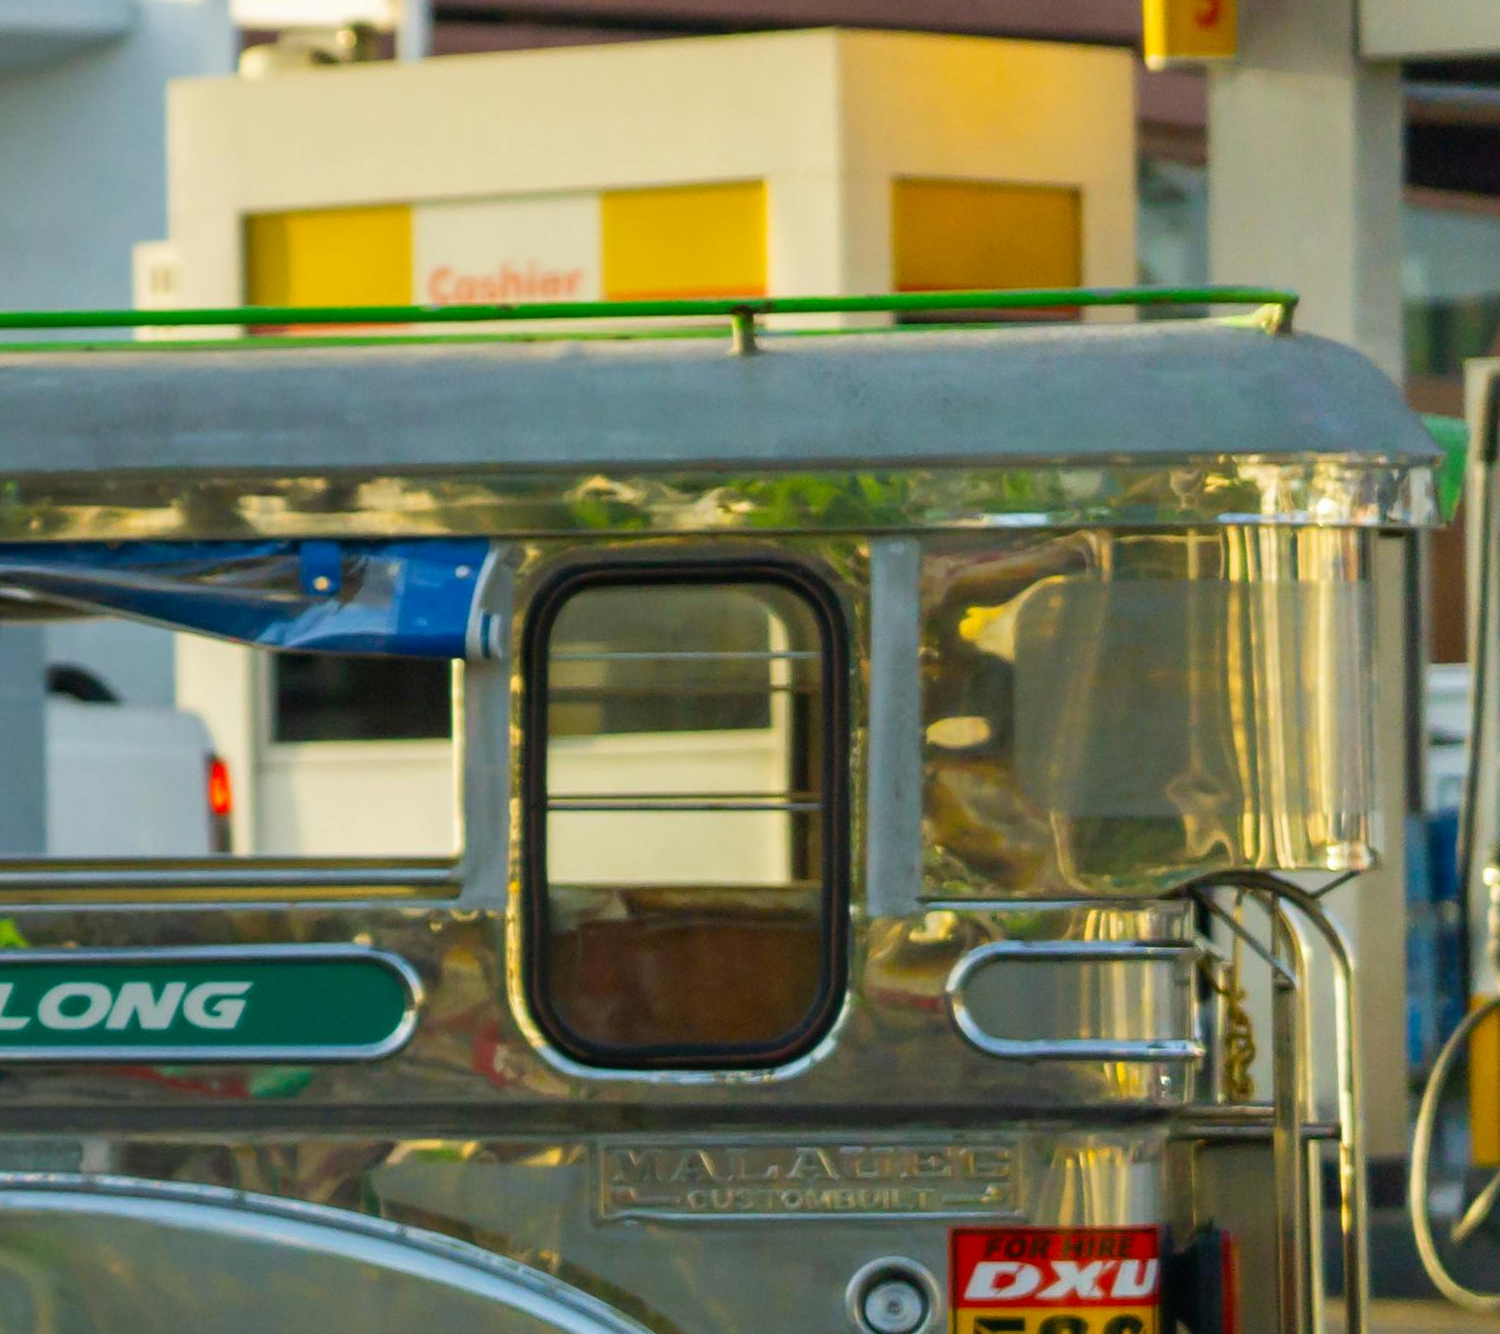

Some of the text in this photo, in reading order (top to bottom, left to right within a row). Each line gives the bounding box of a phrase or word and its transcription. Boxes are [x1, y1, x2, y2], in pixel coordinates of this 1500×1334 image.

[429, 262, 583, 303] Cashier
[985, 1236, 1134, 1258] FOR HIRE
[963, 1259, 1159, 1301] DXU
